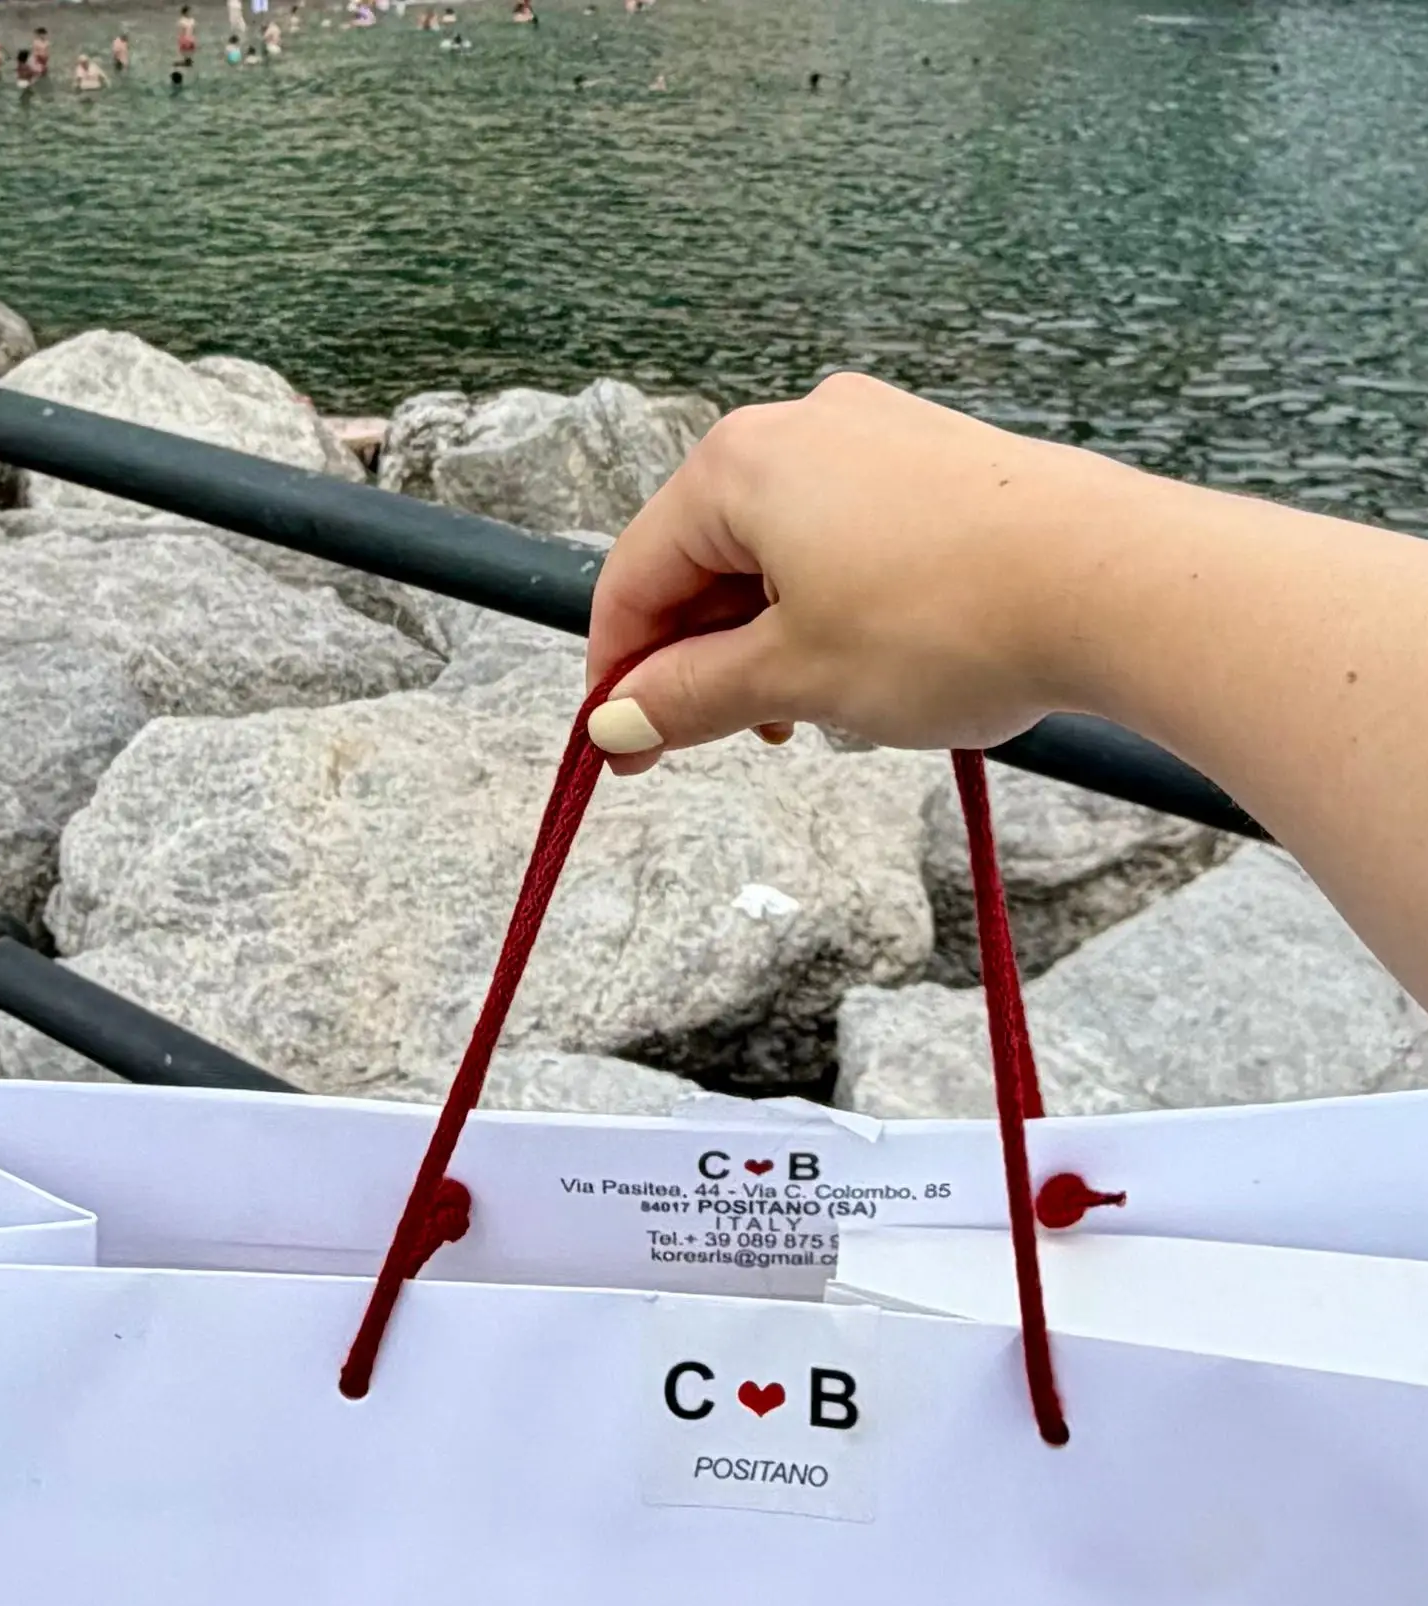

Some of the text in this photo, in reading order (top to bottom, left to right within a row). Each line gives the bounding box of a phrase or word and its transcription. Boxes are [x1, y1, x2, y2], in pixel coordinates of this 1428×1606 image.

[698, 1150, 820, 1181] C B
[560, 1178, 595, 1194] Via
[694, 1183, 720, 1197] 44
[742, 1183, 777, 1198] Via
[785, 1184, 807, 1200] C.
[924, 1183, 952, 1199] 85
[640, 1199, 877, 1218] 84017 POSITANO (SA)
[704, 1232, 730, 1247] 39
[737, 1233, 778, 1248] 089
[784, 1233, 823, 1249] 875
[664, 1360, 860, 1431] C B
[693, 1456, 829, 1488] POSITANO
